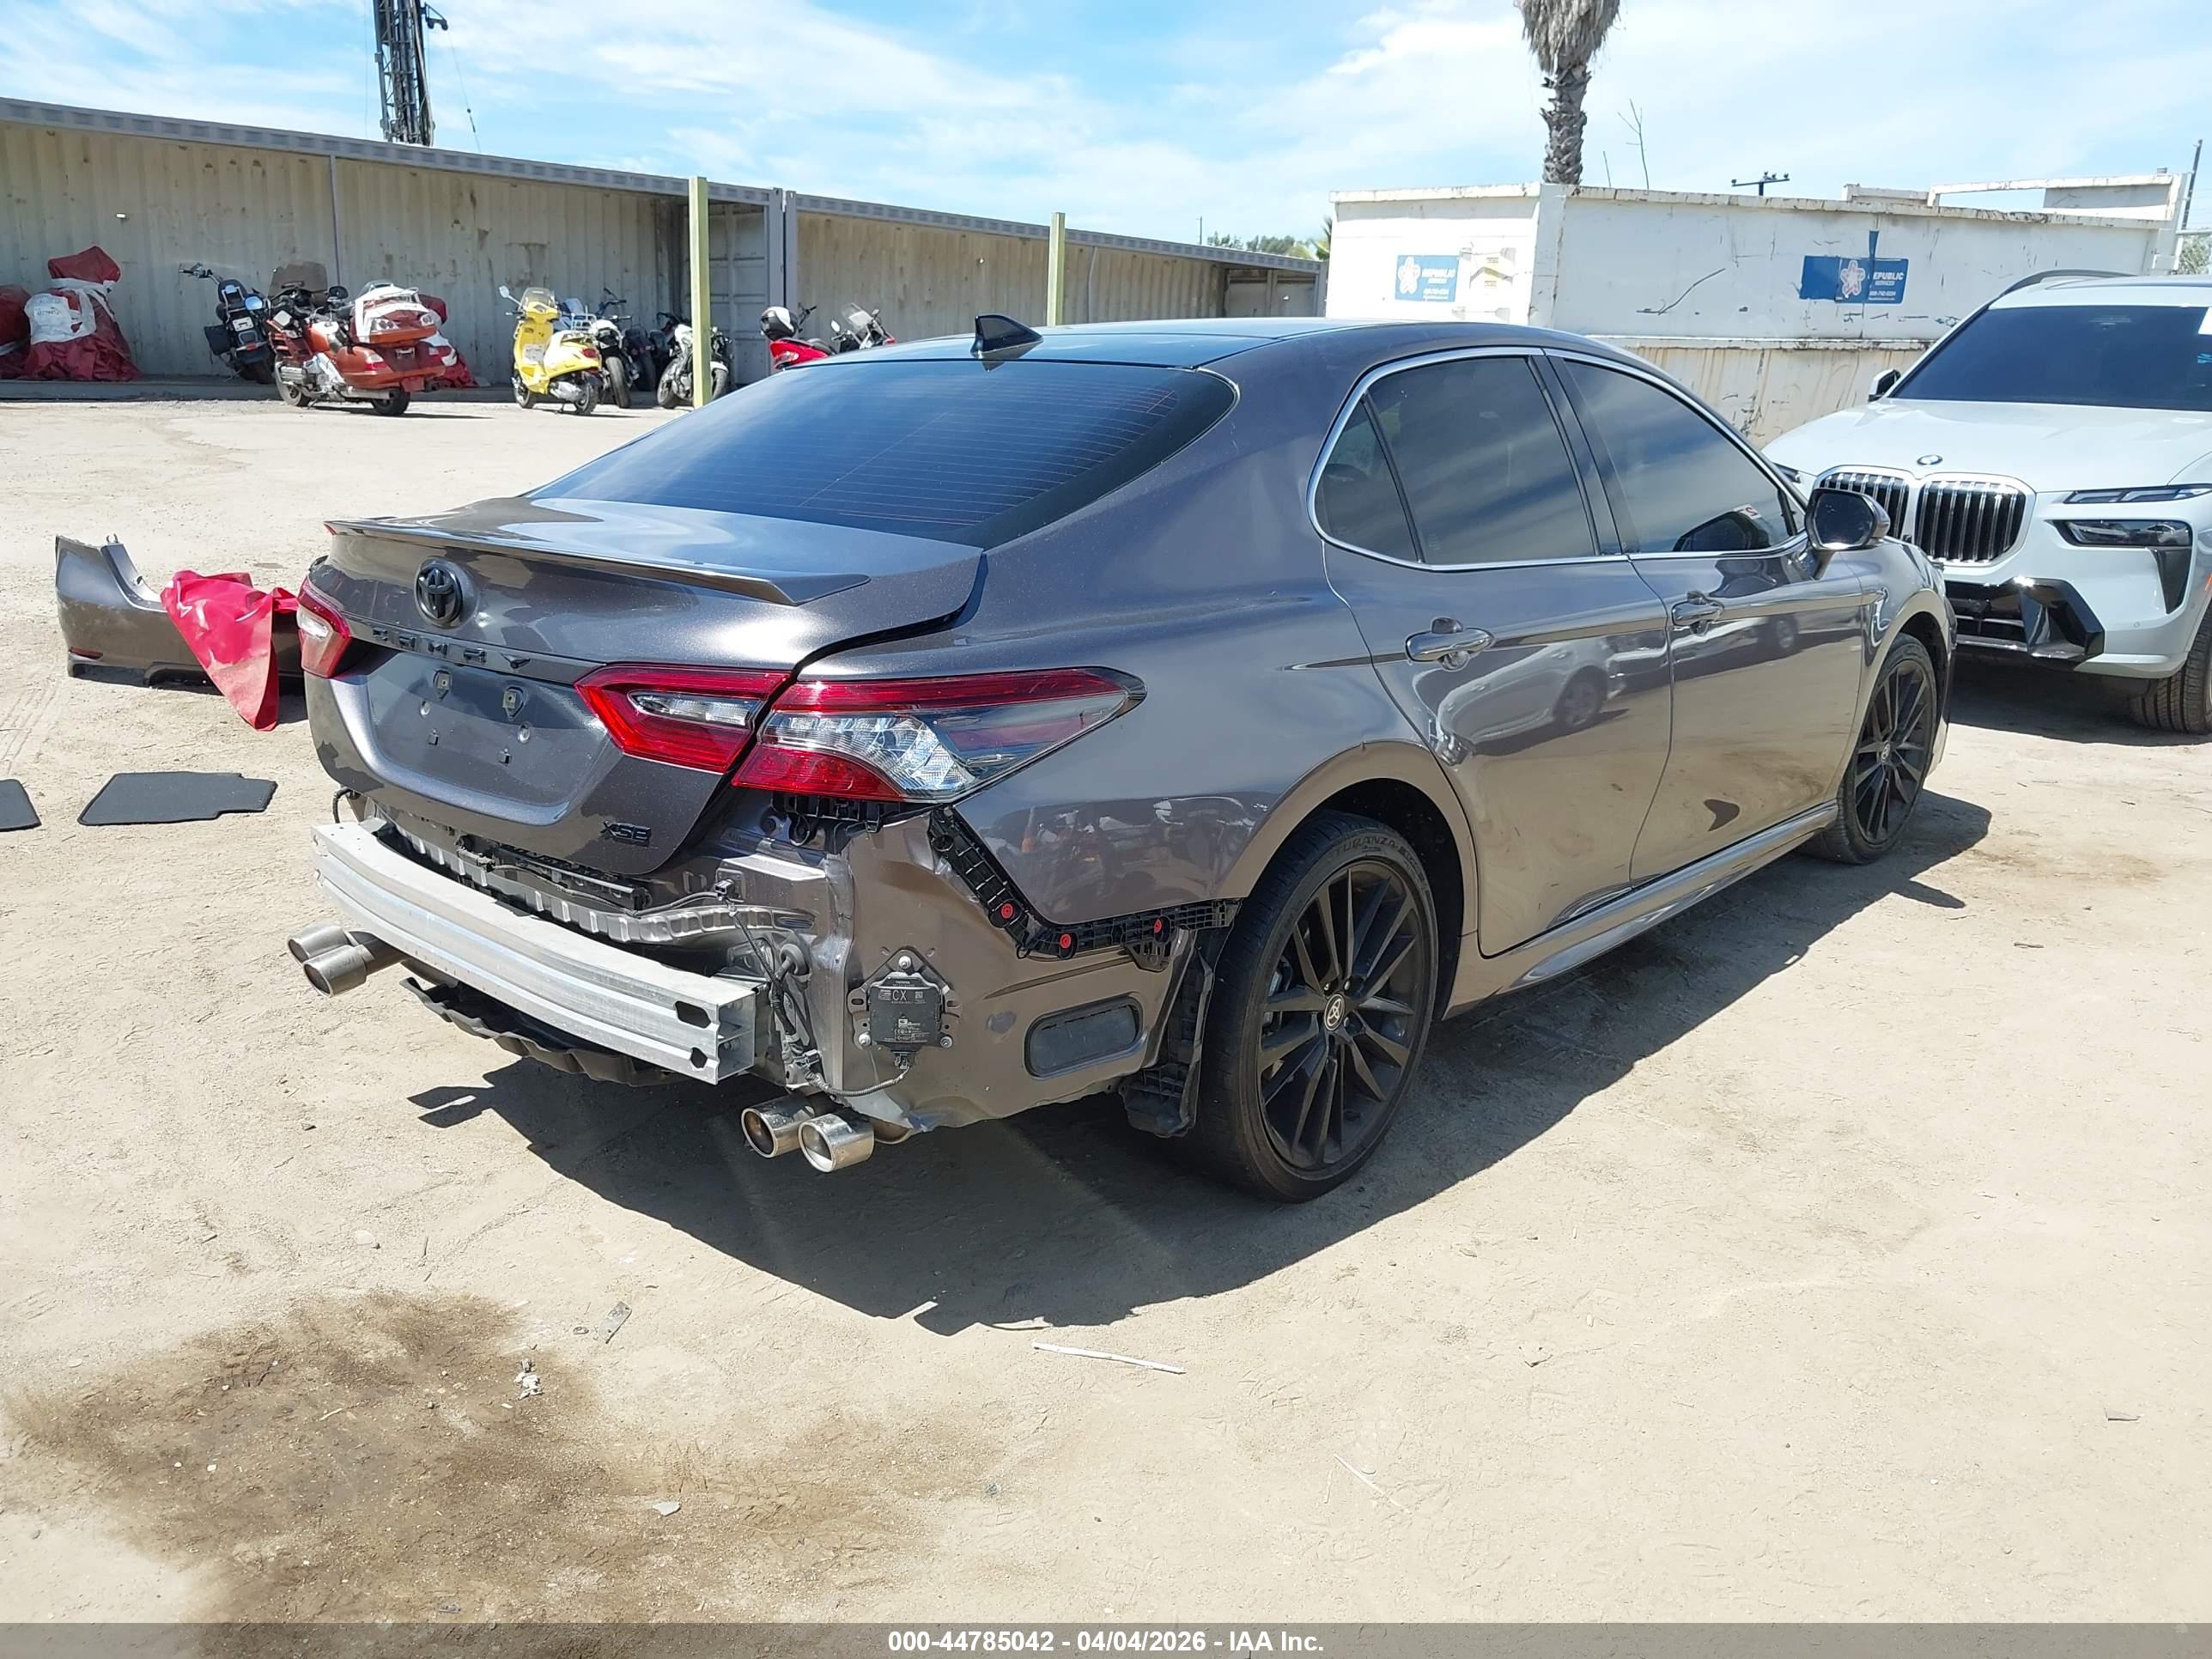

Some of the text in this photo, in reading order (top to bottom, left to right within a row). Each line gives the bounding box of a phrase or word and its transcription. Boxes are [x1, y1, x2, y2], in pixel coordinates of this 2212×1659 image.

[1868, 271, 1905, 281] EPUBLIC
[600, 820, 652, 845] XSE
[892, 989, 907, 1001] CX
